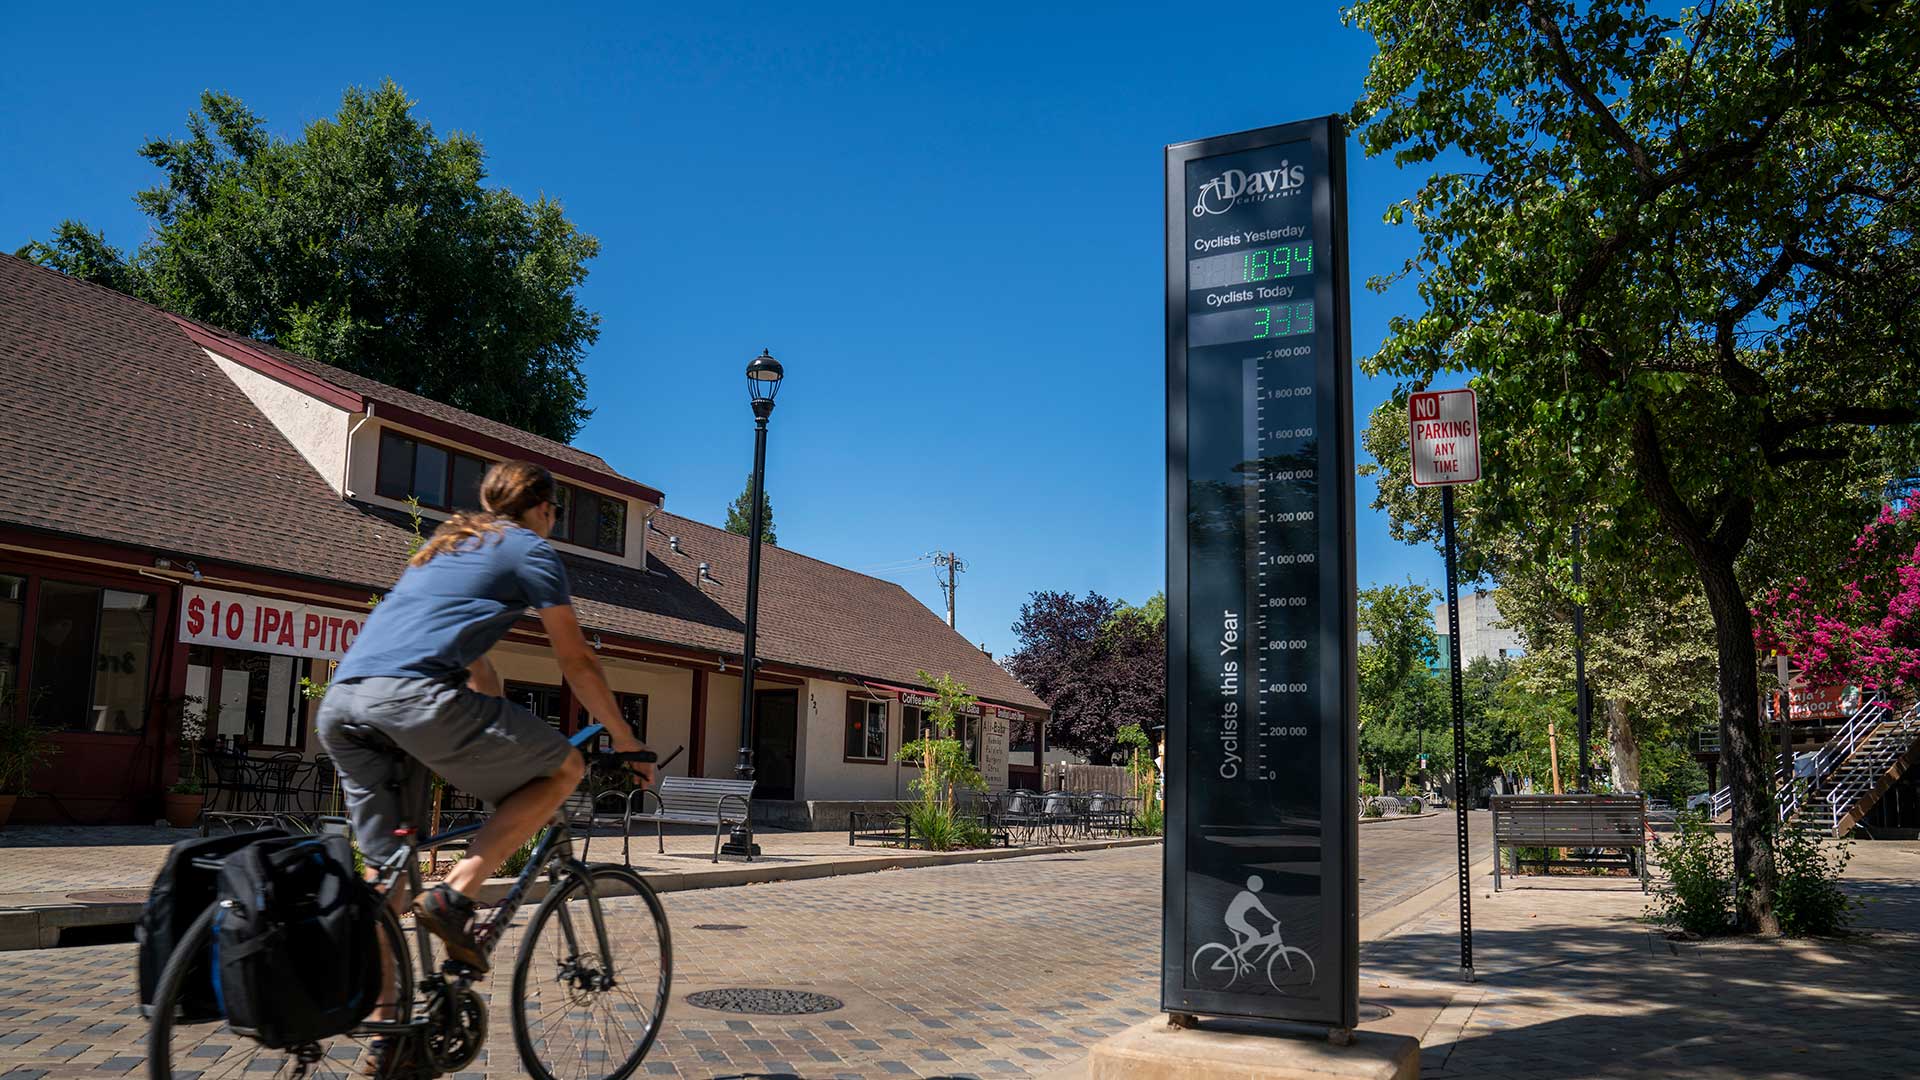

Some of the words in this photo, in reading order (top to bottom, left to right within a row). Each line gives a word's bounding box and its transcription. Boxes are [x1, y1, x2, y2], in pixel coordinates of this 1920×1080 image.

[1222, 159, 1305, 199] Davis
[1194, 234, 1241, 251] Cyclists
[1244, 225, 1305, 243] Yesterday
[1206, 289, 1253, 307] Cyclists
[1257, 285, 1294, 300] Today
[1254, 303, 1313, 339] 339
[1416, 398, 1436, 418] NO
[1417, 420, 1471, 440] PARKING
[1435, 443, 1455, 456] ANY
[1433, 459, 1458, 473] TIME
[187, 594, 244, 641] $10
[253, 606, 294, 647] IPA
[303, 613, 366, 653] PITC
[1220, 610, 1237, 656] Year
[1220, 661, 1237, 696] this
[902, 693, 922, 705] Coffee
[1220, 702, 1242, 779] Cyclists
[1269, 771, 1276, 780] 0
